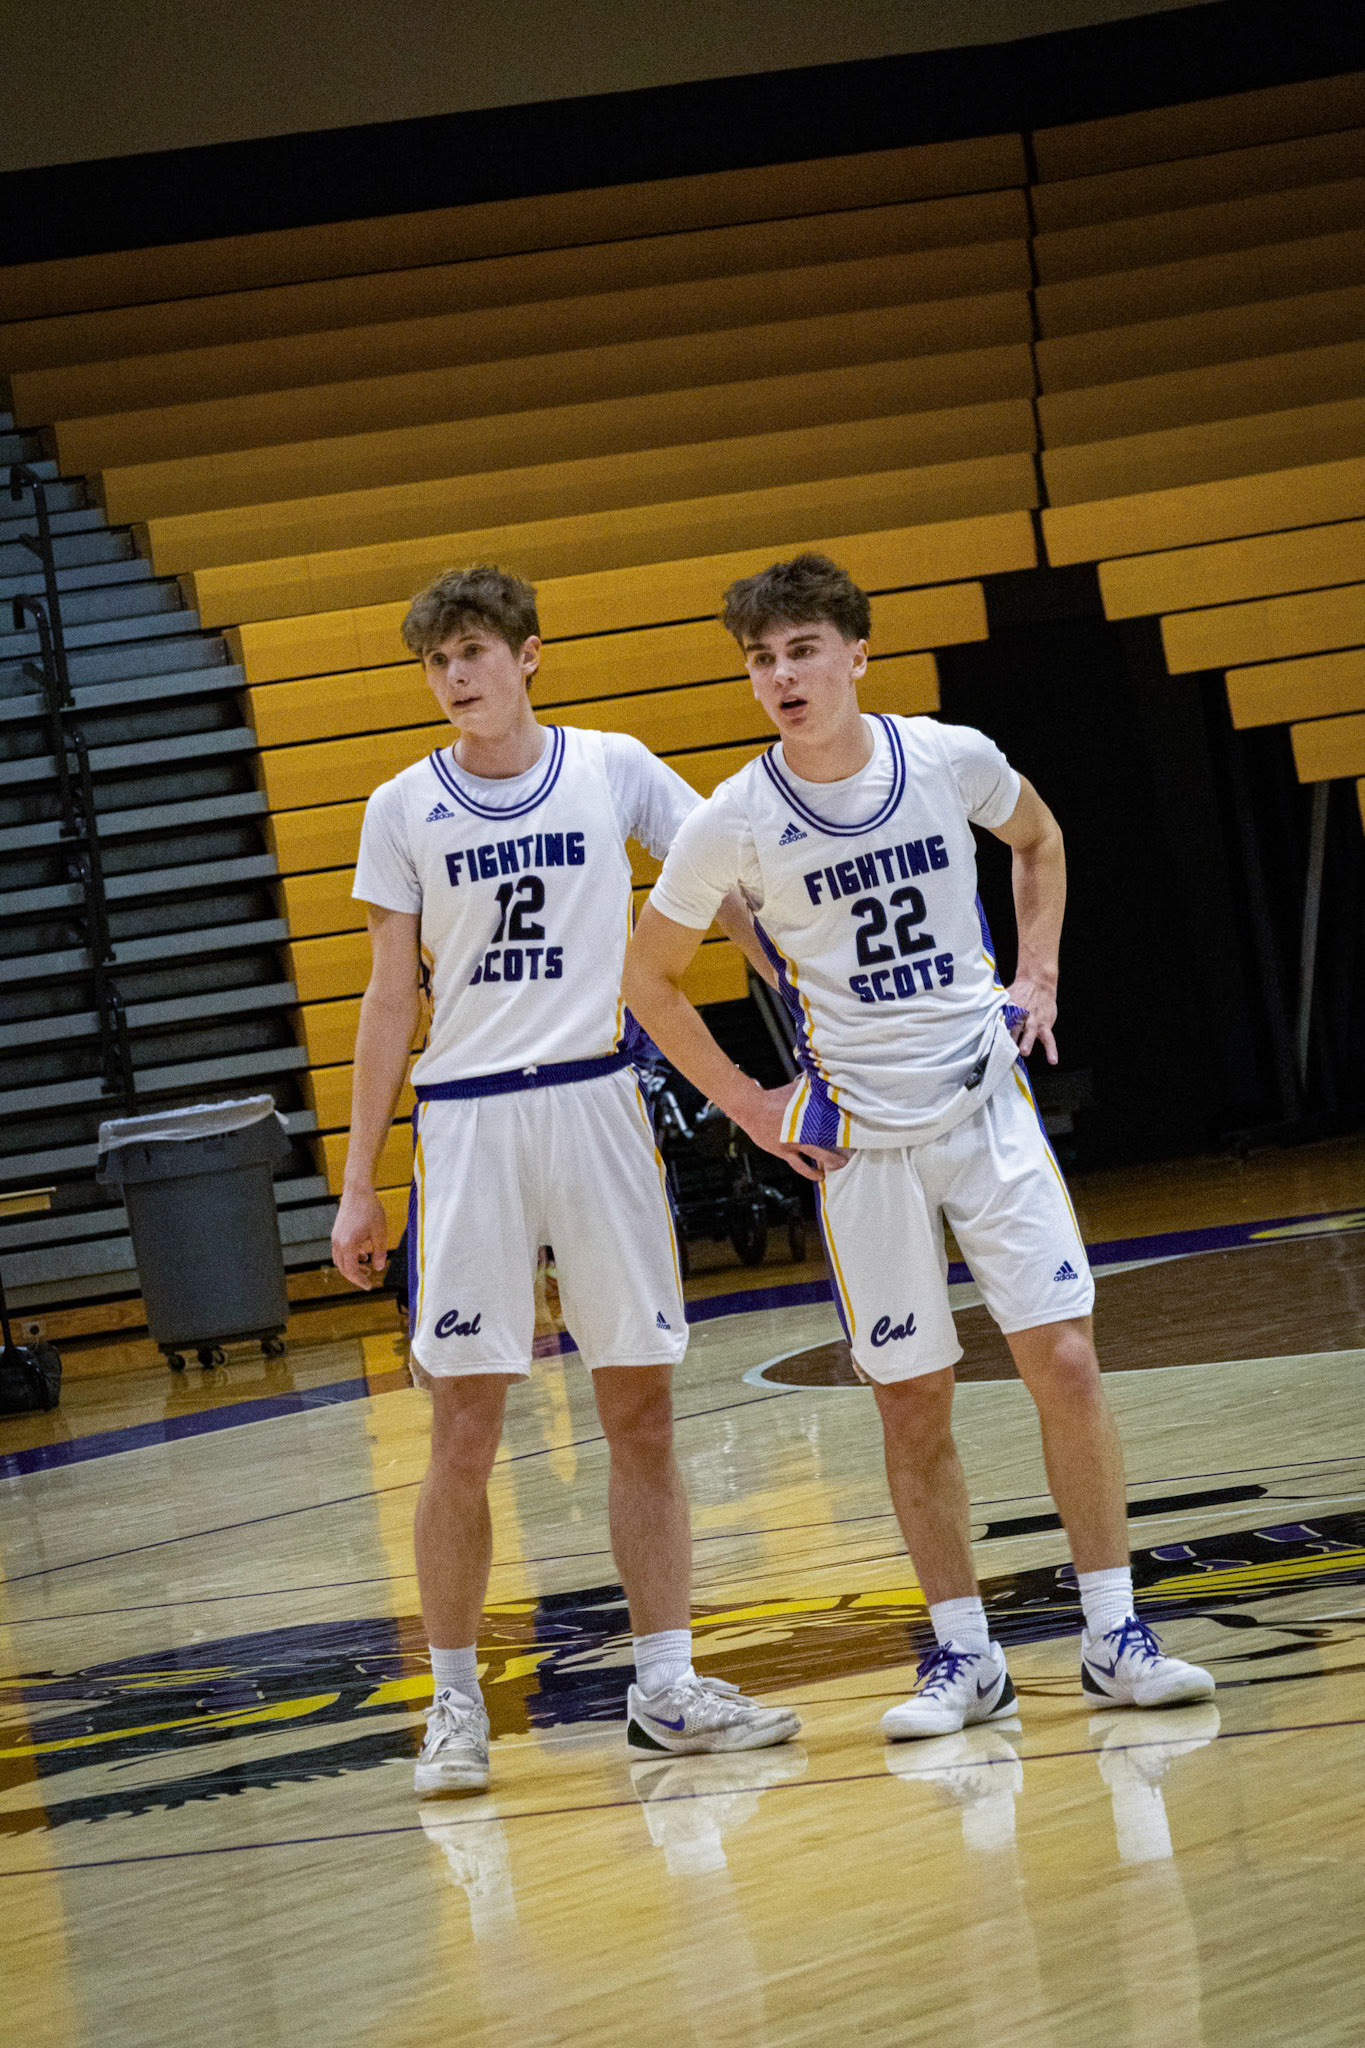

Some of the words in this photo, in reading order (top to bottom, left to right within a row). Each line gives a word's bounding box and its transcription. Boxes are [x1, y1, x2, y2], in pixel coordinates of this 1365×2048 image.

[426, 812, 455, 822] adidas
[445, 832, 585, 887] FIGHTING
[779, 832, 808, 846] adidas
[803, 834, 949, 906] FIGHTING
[491, 874, 545, 944] 12
[850, 886, 936, 967] 22
[849, 952, 954, 1003] SCOTS
[1053, 1272, 1078, 1282] adidas
[434, 1309, 481, 1339] Cal
[870, 1312, 917, 1348] Cal
